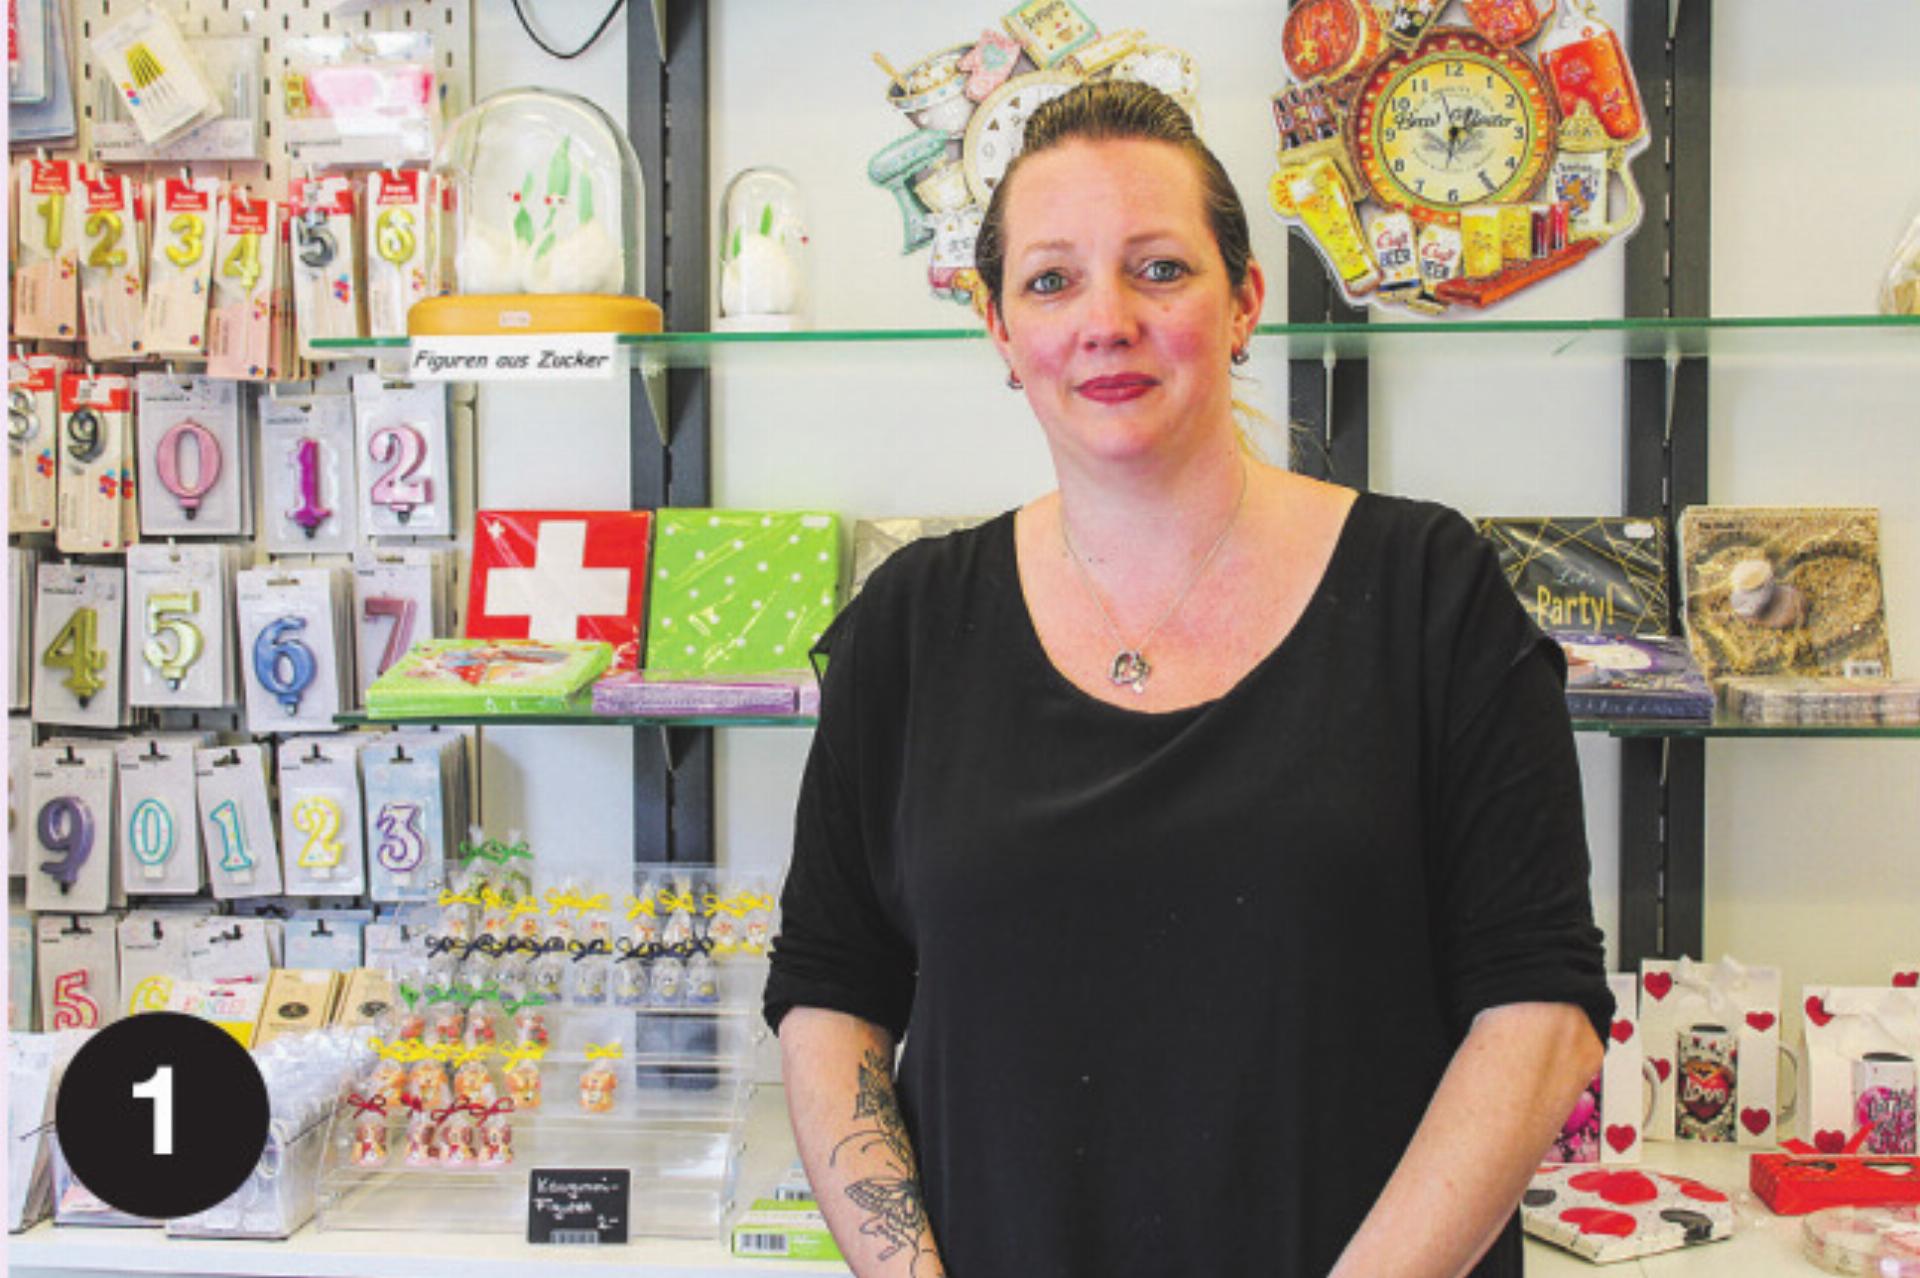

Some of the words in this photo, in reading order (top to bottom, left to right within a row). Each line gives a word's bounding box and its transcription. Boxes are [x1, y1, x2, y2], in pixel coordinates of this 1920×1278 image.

[1411, 78, 1429, 93] 11
[1445, 61, 1464, 77] 12
[1486, 74, 1494, 89] 1
[1391, 96, 1411, 112] 10
[1504, 94, 1515, 109] 2
[1385, 128, 1396, 142] 9
[1514, 126, 1524, 140] 3
[1394, 158, 1405, 172] 8
[1414, 179, 1425, 193] 7
[1505, 156, 1515, 169] 4
[37, 192, 65, 250] 1
[1448, 189, 1459, 202] 6
[85, 208, 128, 268] 2
[165, 213, 205, 267] 3
[223, 234, 261, 289] 4
[297, 211, 337, 268] 5
[376, 207, 416, 265] 6
[413, 350, 488, 374] Figuren
[495, 353, 530, 370] aus
[537, 350, 610, 370] Zucker
[67, 407, 107, 464] 9
[156, 421, 223, 502] 0
[286, 438, 332, 527] 1
[368, 424, 435, 506] 2
[143, 590, 205, 672] 5
[1537, 581, 1615, 635] Party!
[41, 607, 108, 690] 4
[253, 615, 318, 698] 6
[363, 597, 418, 677] 7
[37, 795, 95, 878] 9
[129, 798, 173, 866] 0
[210, 799, 252, 871] 1
[292, 797, 344, 868] 2
[376, 803, 424, 873] 3
[53, 968, 99, 1031] 5
